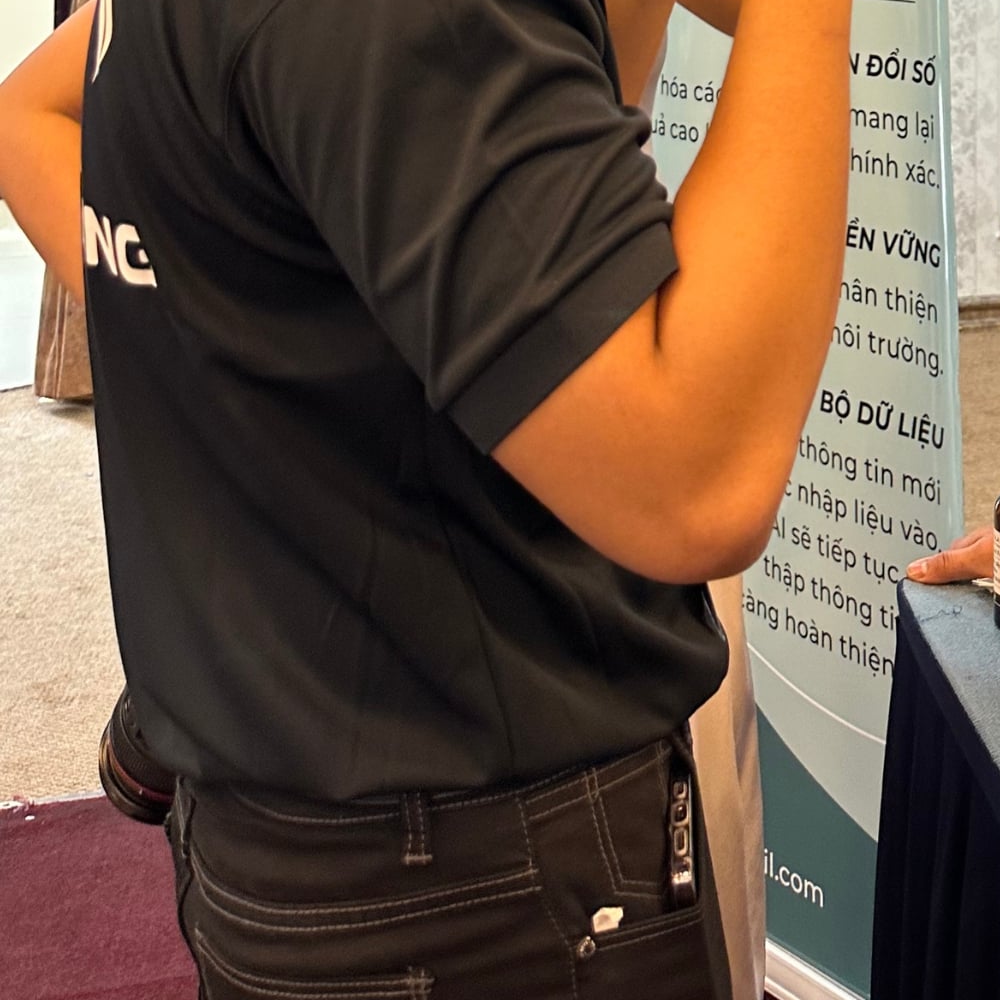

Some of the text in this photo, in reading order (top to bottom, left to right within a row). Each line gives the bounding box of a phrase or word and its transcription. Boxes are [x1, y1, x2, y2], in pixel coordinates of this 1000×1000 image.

[866, 48, 907, 80] ĐỔI
[912, 55, 936, 86] SỐ
[661, 74, 687, 99] hóa
[850, 108, 908, 139] mang
[916, 111, 934, 143] lại
[670, 123, 699, 143] cao
[851, 147, 898, 178] hính
[905, 160, 940, 189] xác.
[846, 217, 941, 267] ỀN VỮNG
[885, 287, 937, 324] thiện
[868, 331, 943, 377] trường.
[820, 389, 945, 449] BỘ DỮ LIỆU
[799, 435, 941, 505] thông tin mới
[798, 482, 847, 522] nhập
[854, 499, 893, 535] liệu
[791, 525, 811, 550] sẽ
[817, 534, 857, 572] tiếp
[863, 552, 899, 584] tục
[763, 555, 900, 631] thập thông ti
[742, 588, 894, 677] àng hoàn thiện
